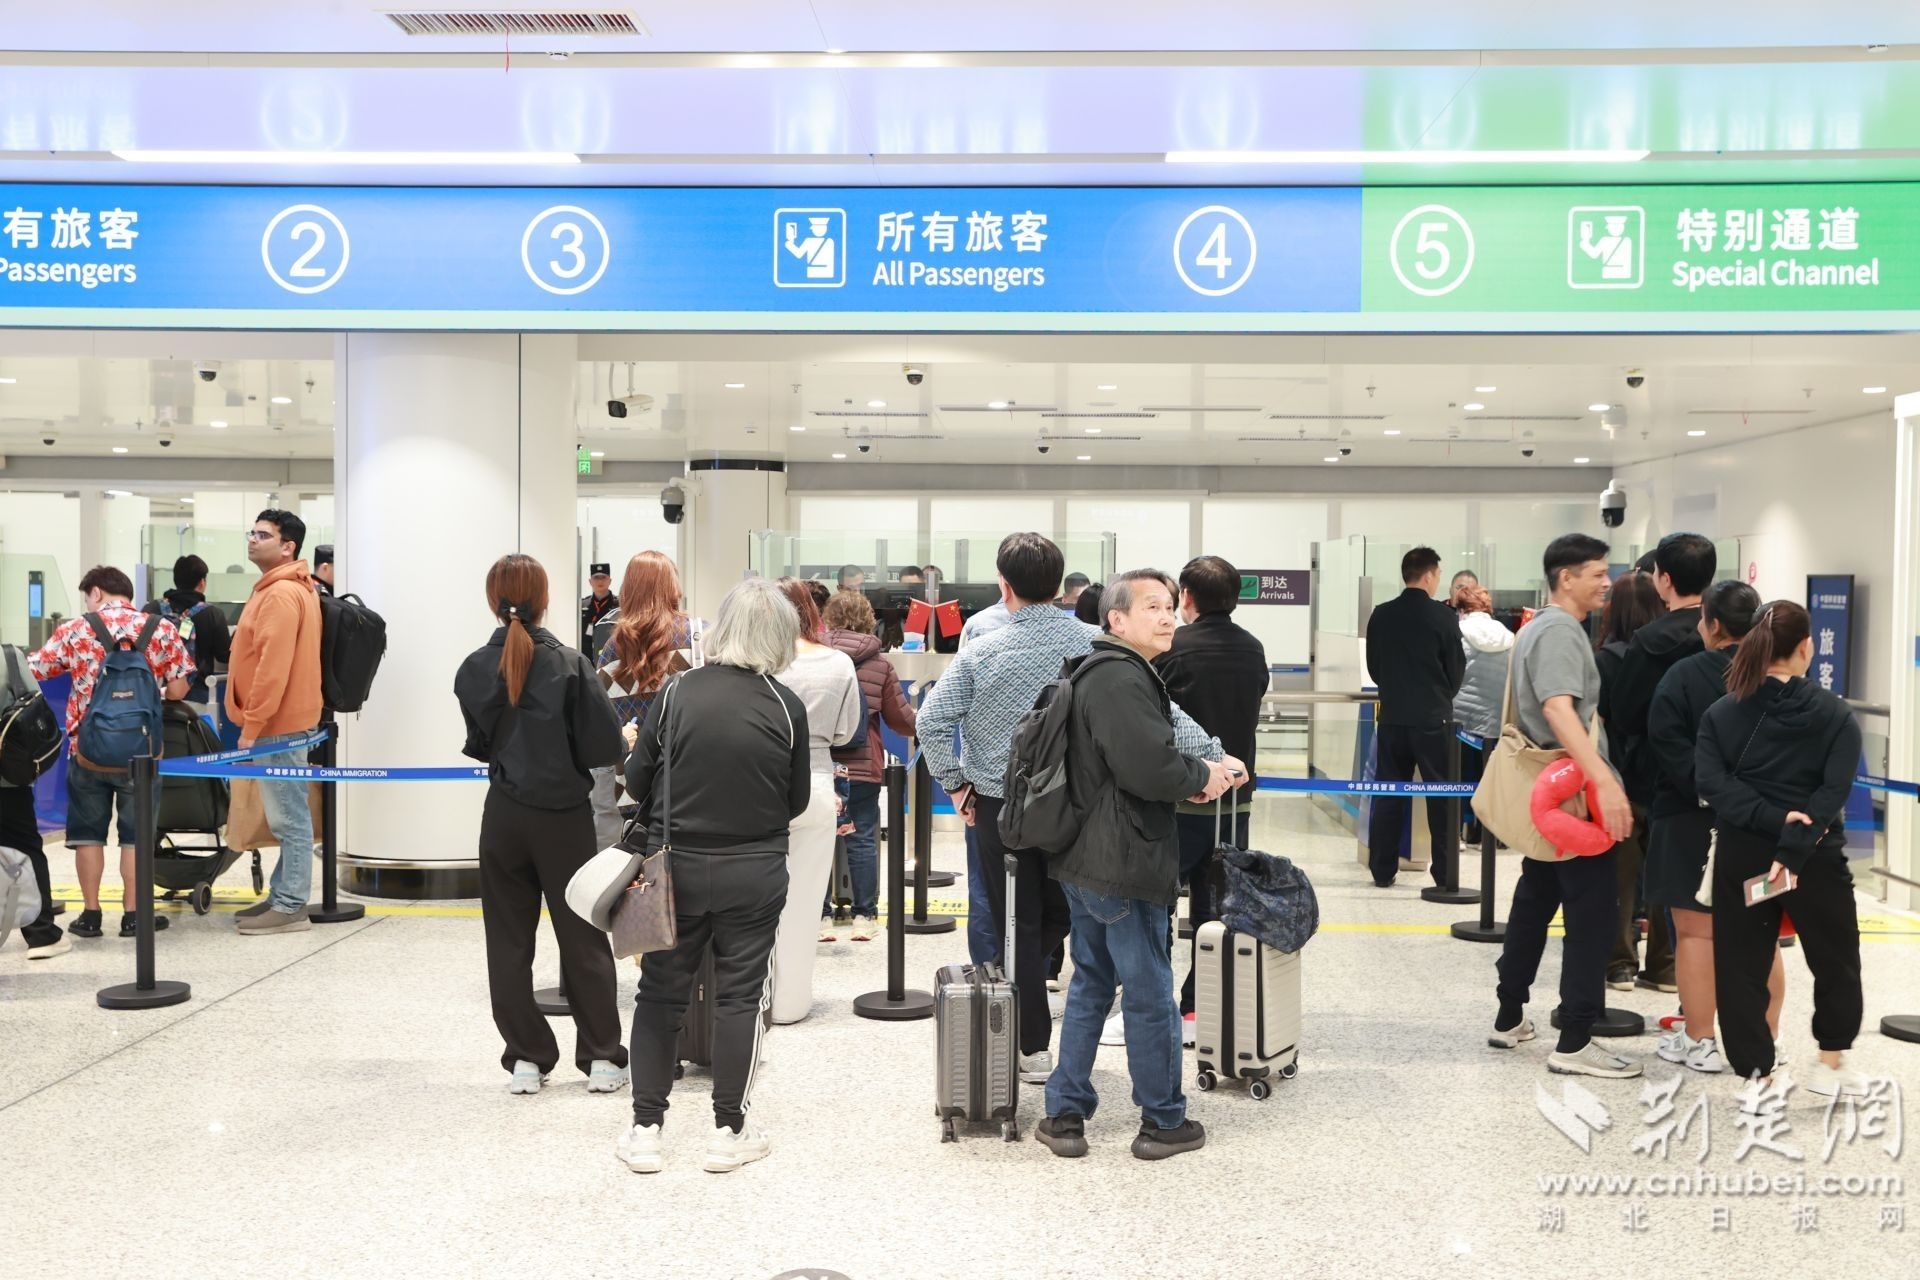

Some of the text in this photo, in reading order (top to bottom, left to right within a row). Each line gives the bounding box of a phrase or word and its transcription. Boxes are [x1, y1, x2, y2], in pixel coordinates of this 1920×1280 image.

[3, 207, 139, 249] 有旅客
[289, 221, 326, 277] 2
[876, 210, 1048, 252] 所有旅客
[1676, 207, 1859, 252] 特别通道
[549, 222, 586, 278] 3
[1196, 222, 1232, 279] 4
[1414, 222, 1450, 279] 5
[873, 261, 1045, 292] All Passengers
[1672, 259, 1879, 292] Special Channel
[1260, 591, 1295, 600] Arrivals
[1261, 576, 1288, 589] 到达
[319, 769, 342, 777] CHINA
[342, 770, 388, 778] IMMIGRATION
[1403, 784, 1426, 792] CHINA
[1427, 784, 1474, 792] IMMIGRATION
